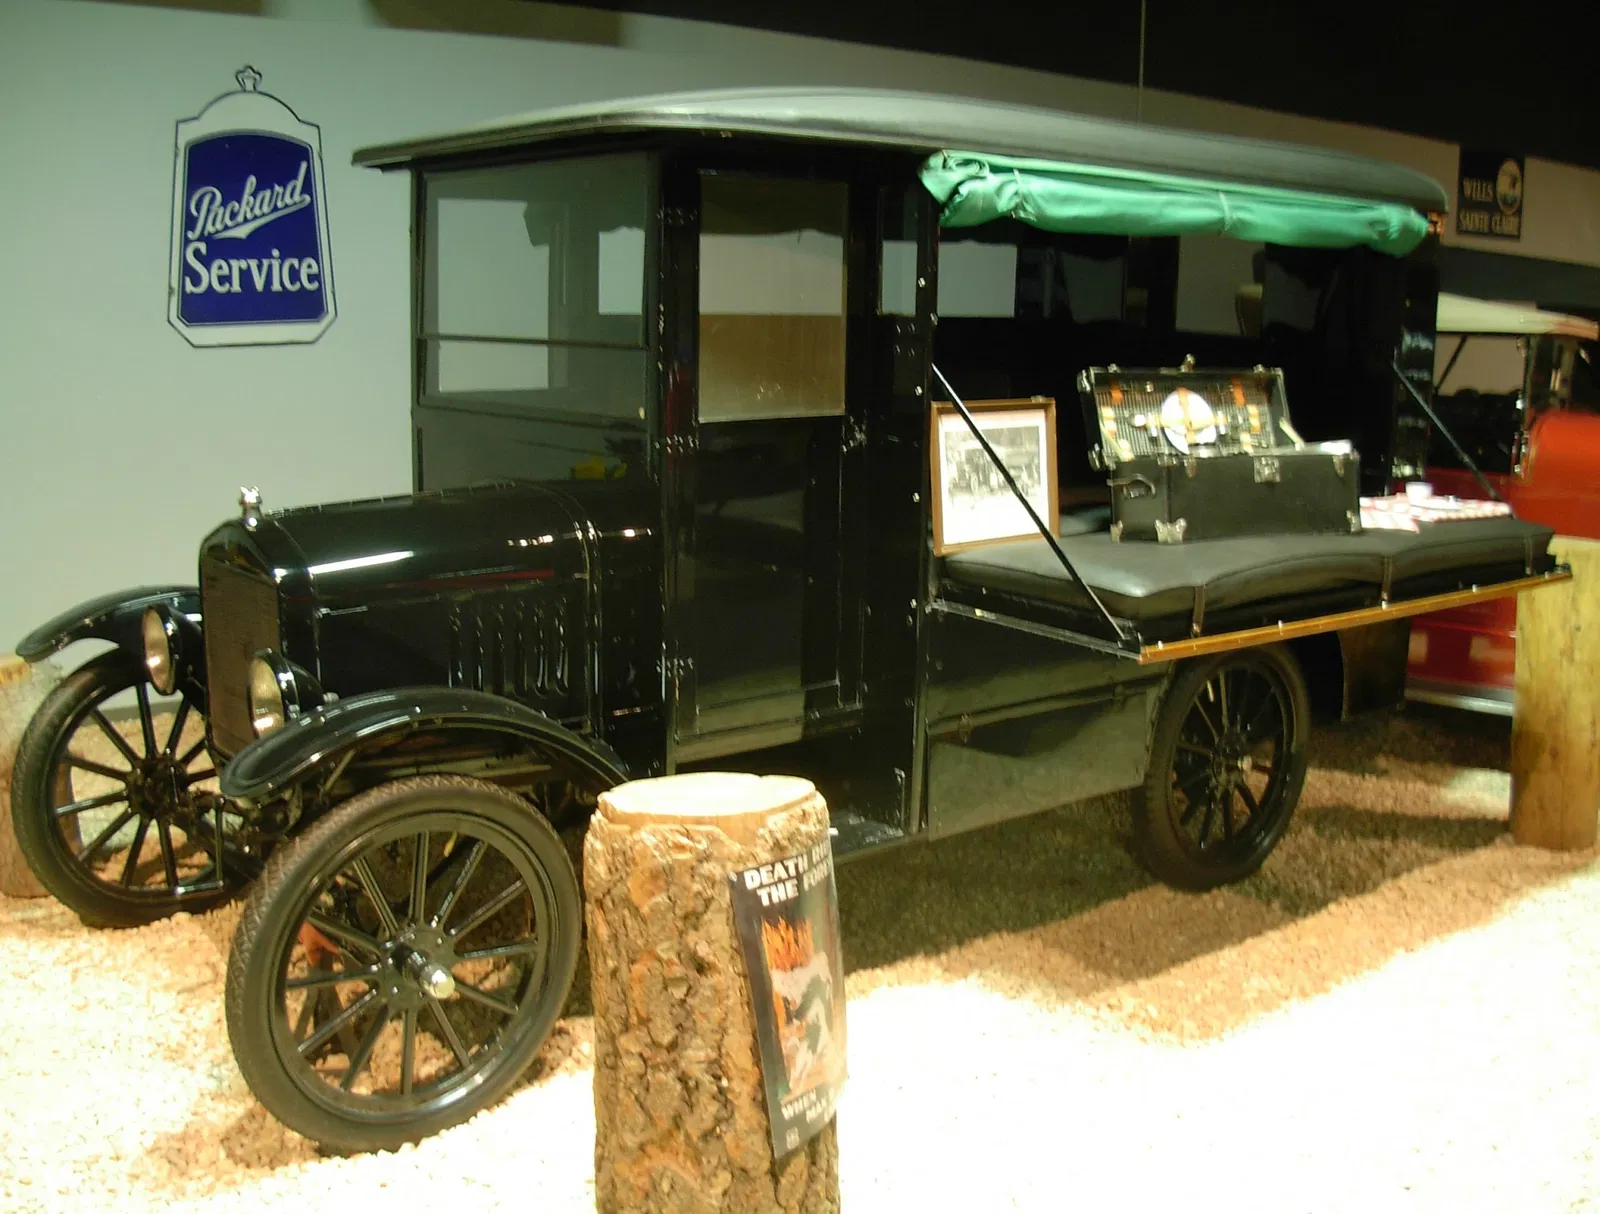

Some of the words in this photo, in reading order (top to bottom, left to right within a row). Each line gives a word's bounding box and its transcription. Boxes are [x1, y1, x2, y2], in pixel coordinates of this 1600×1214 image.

[187, 160, 311, 240] Packard
[184, 240, 320, 294] Service
[743, 852, 809, 891] DEATH
[756, 878, 800, 907] THE
